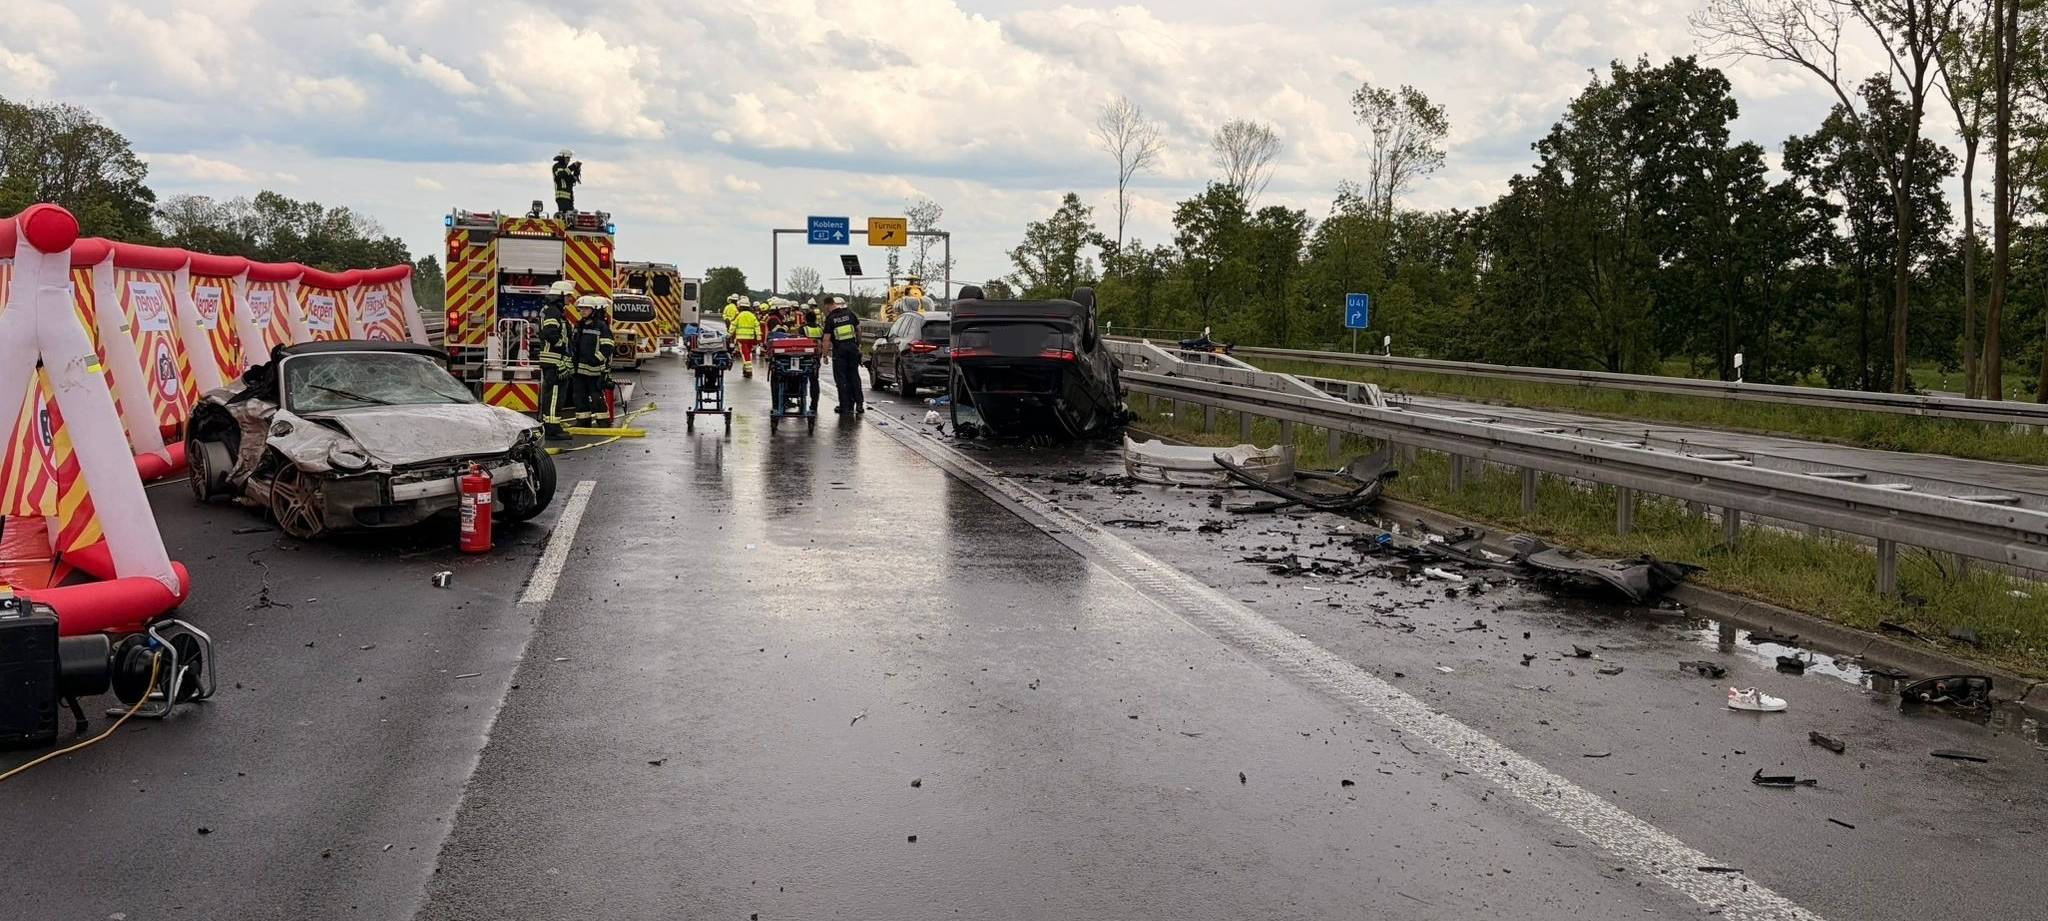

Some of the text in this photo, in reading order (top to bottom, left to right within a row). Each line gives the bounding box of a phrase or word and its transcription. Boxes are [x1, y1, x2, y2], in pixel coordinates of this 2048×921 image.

[813, 220, 844, 229] Koblenz
[308, 299, 333, 320] Kerpen
[614, 303, 651, 313] NOTARZT
[833, 315, 850, 324] POLIZEI
